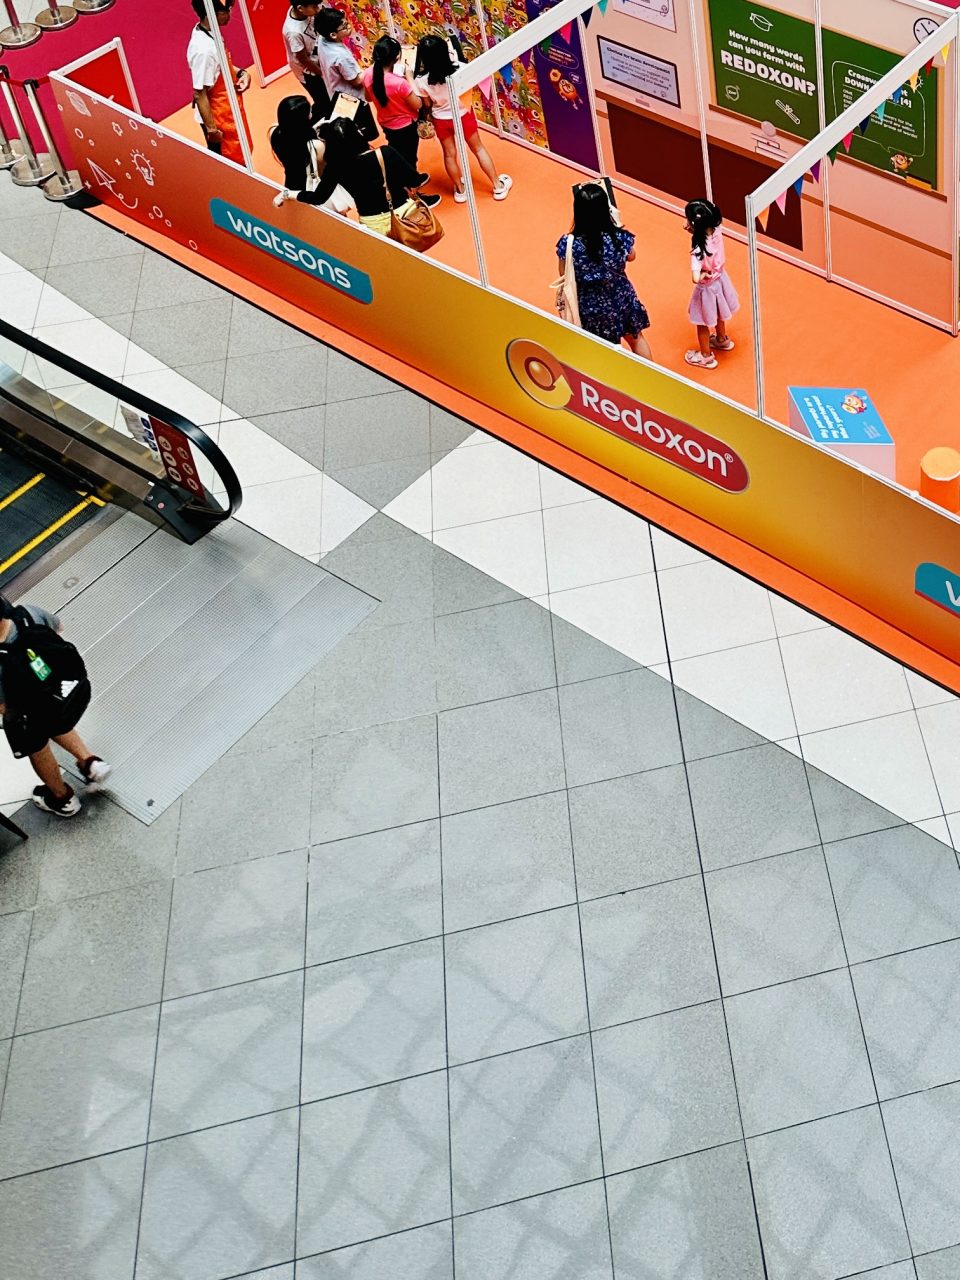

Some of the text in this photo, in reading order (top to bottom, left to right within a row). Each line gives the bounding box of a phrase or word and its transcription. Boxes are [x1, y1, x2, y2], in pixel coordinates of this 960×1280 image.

[728, 40, 806, 73] can you form with
[729, 29, 804, 62] How many words
[720, 49, 816, 97] REDOXON?
[844, 76, 870, 90] DOWN
[226, 210, 352, 290] watsons
